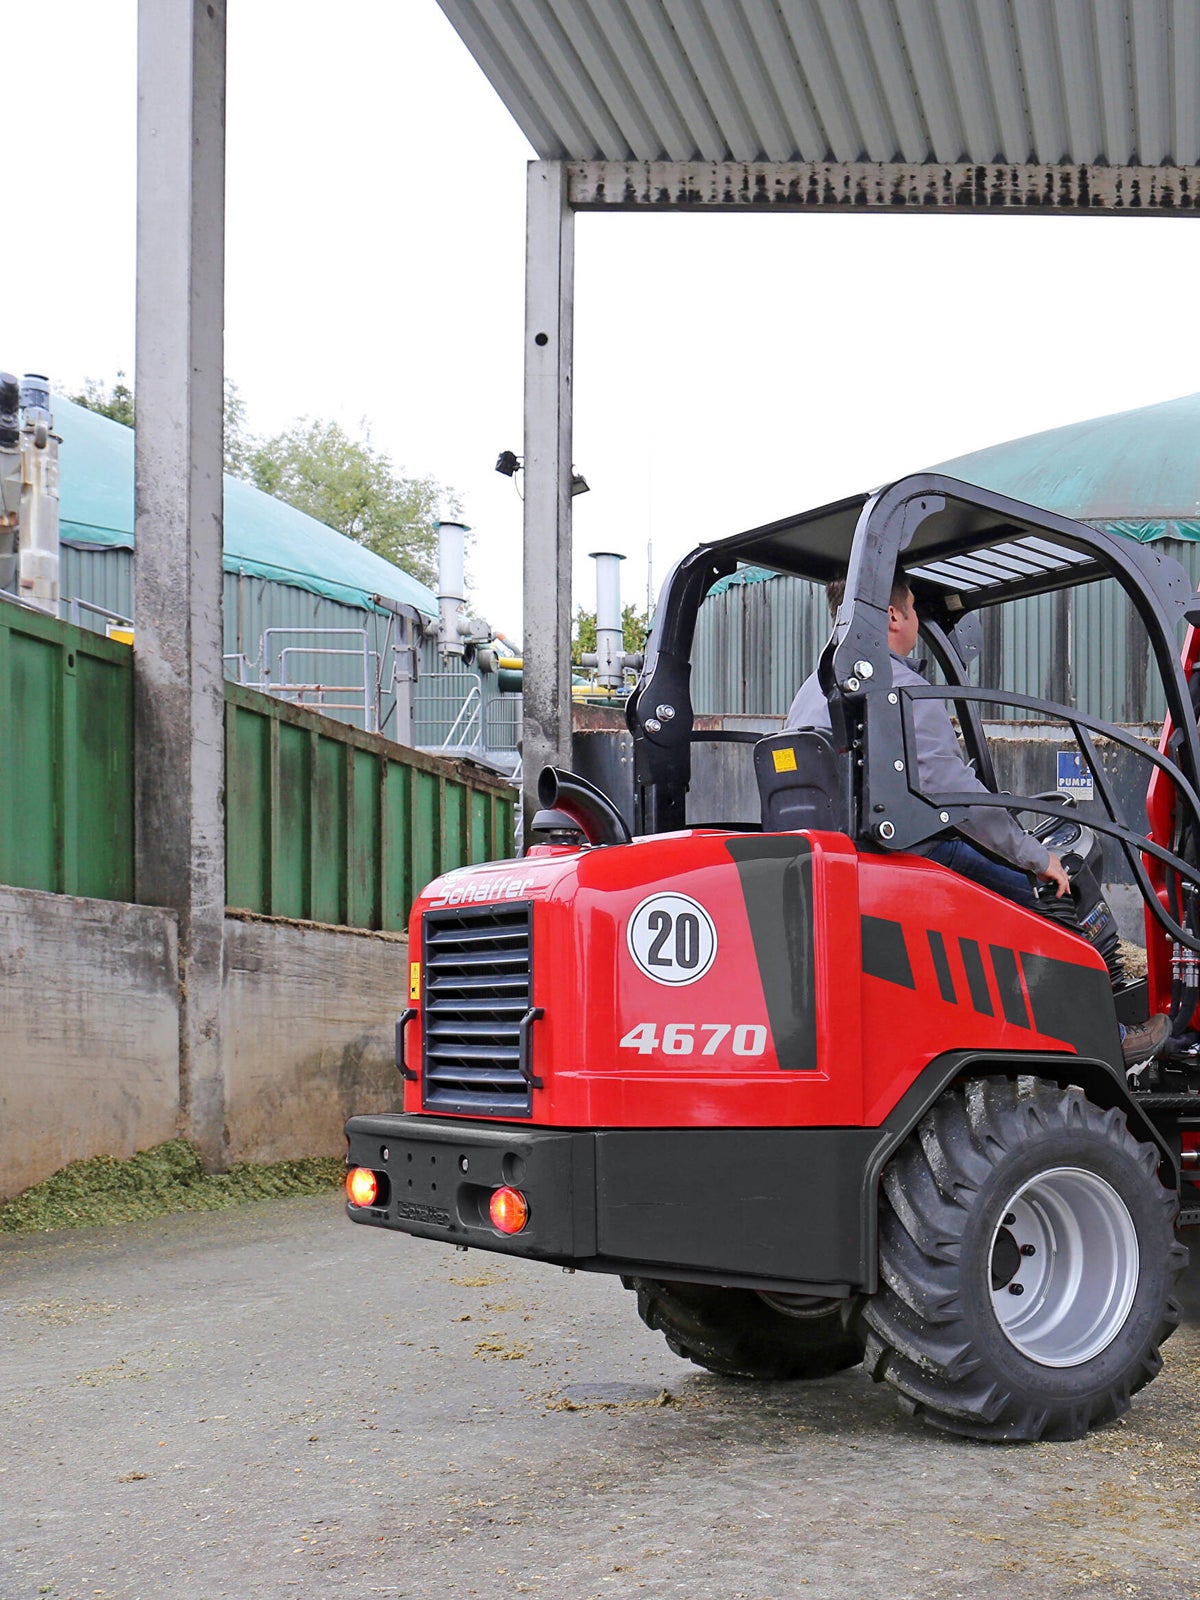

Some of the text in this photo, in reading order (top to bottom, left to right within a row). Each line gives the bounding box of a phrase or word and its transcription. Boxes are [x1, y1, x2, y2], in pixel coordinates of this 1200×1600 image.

[1059, 778, 1092, 787] PUMPE
[429, 876, 535, 908] Schäffer
[647, 910, 700, 969] 20
[619, 1022, 768, 1056] 4670
